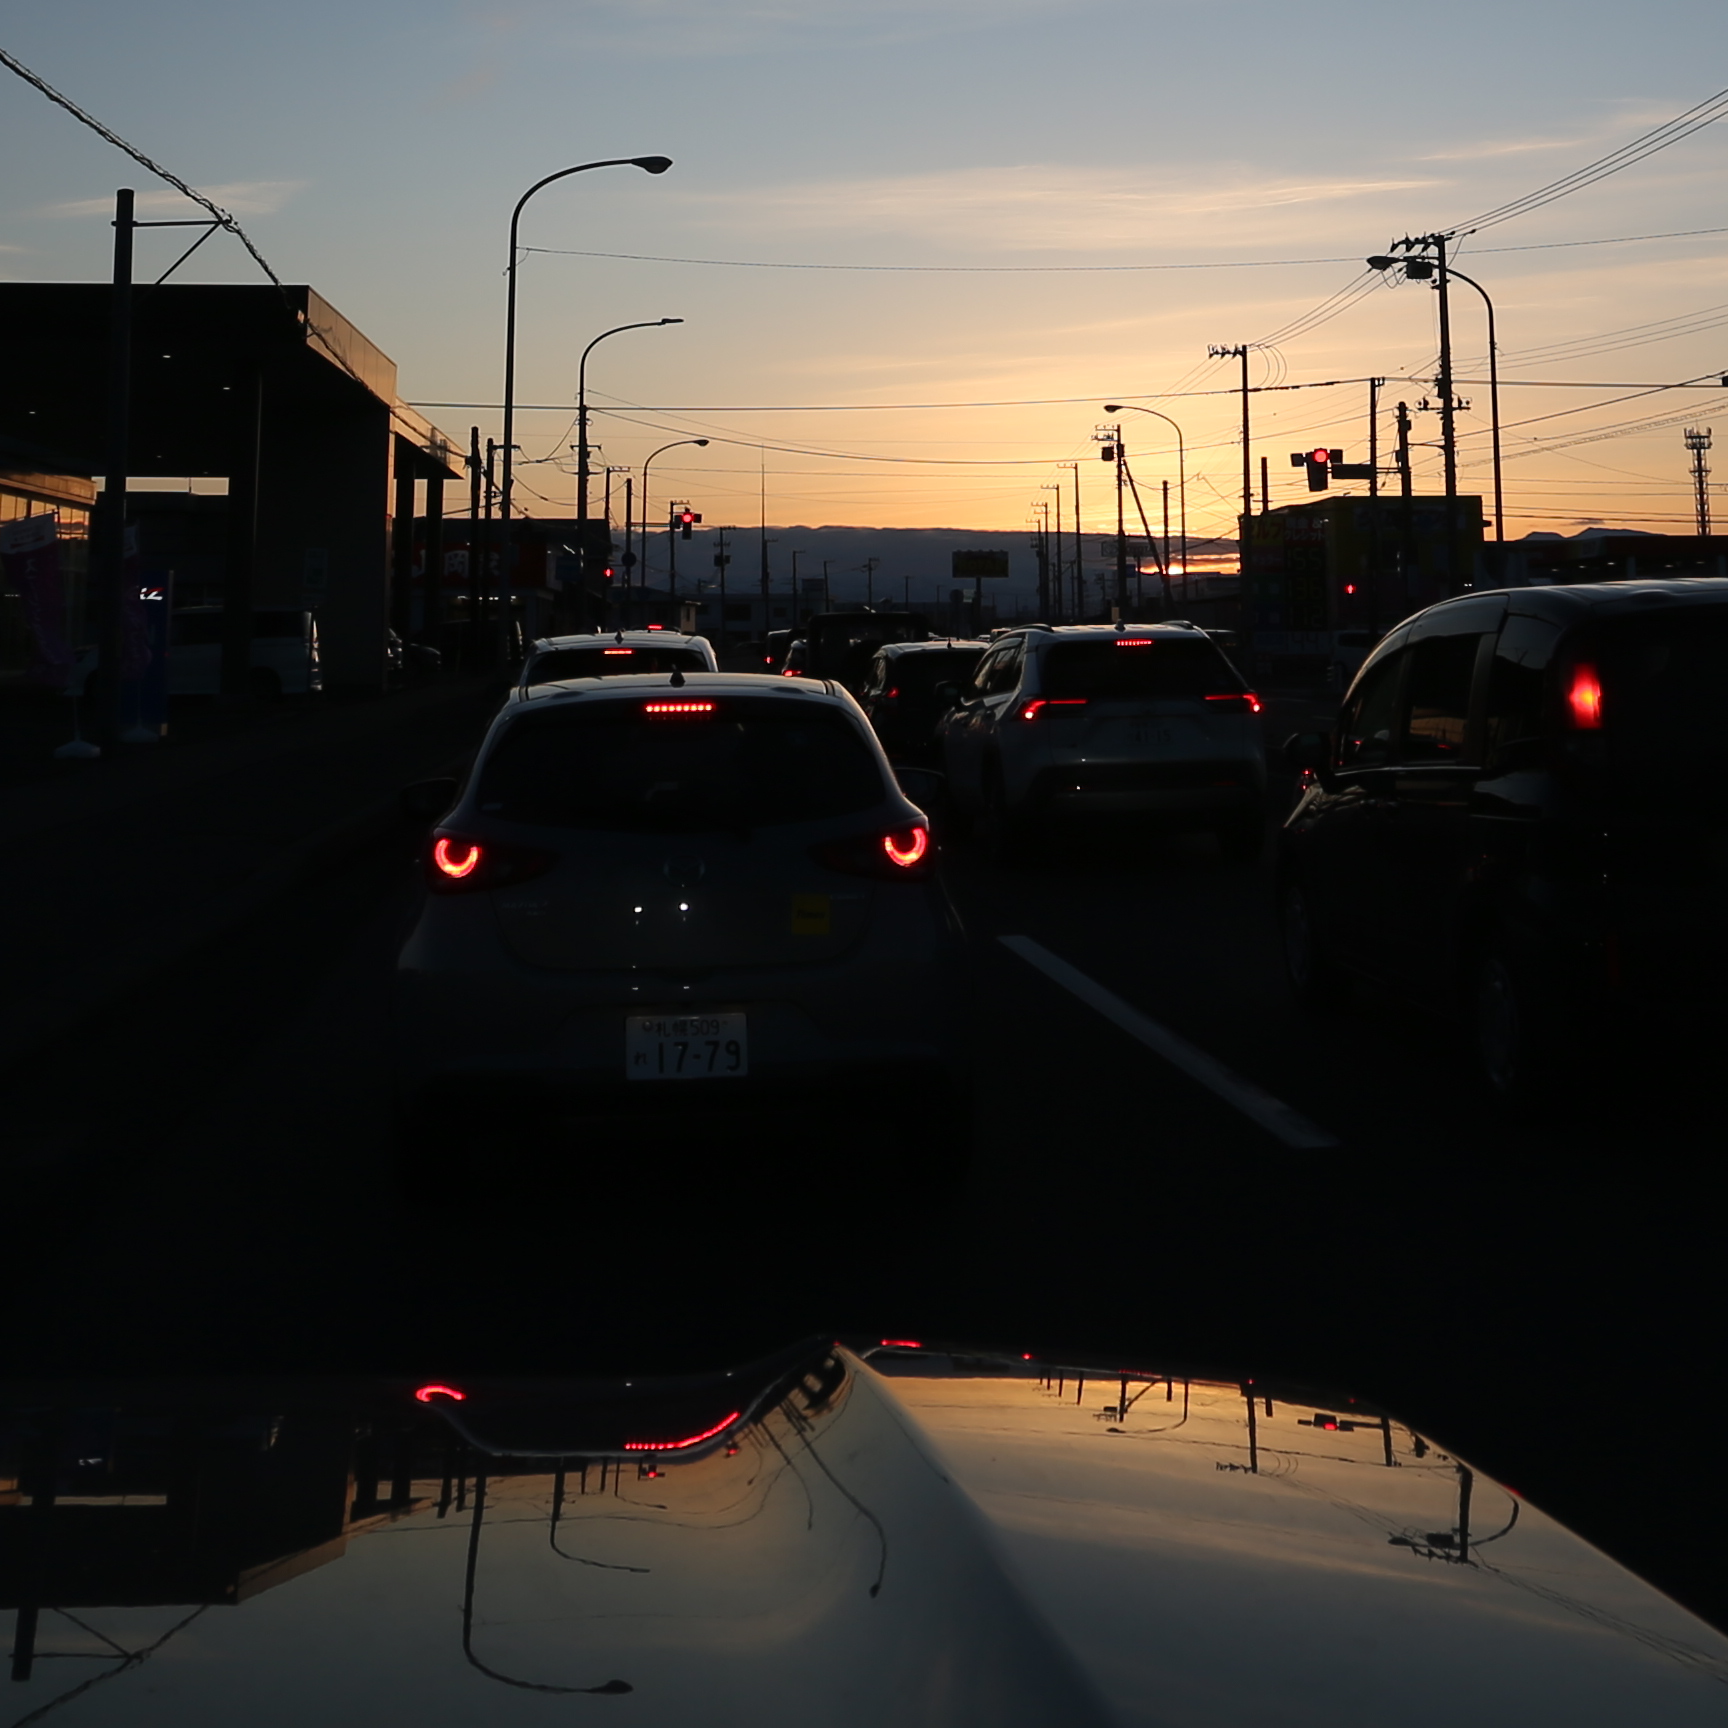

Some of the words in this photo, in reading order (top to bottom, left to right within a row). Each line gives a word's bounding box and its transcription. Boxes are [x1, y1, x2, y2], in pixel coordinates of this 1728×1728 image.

[1288, 548, 1322, 570] 155
[1288, 577, 1323, 600] 136
[1289, 605, 1323, 628] 112
[658, 1040, 741, 1074] 17-79
